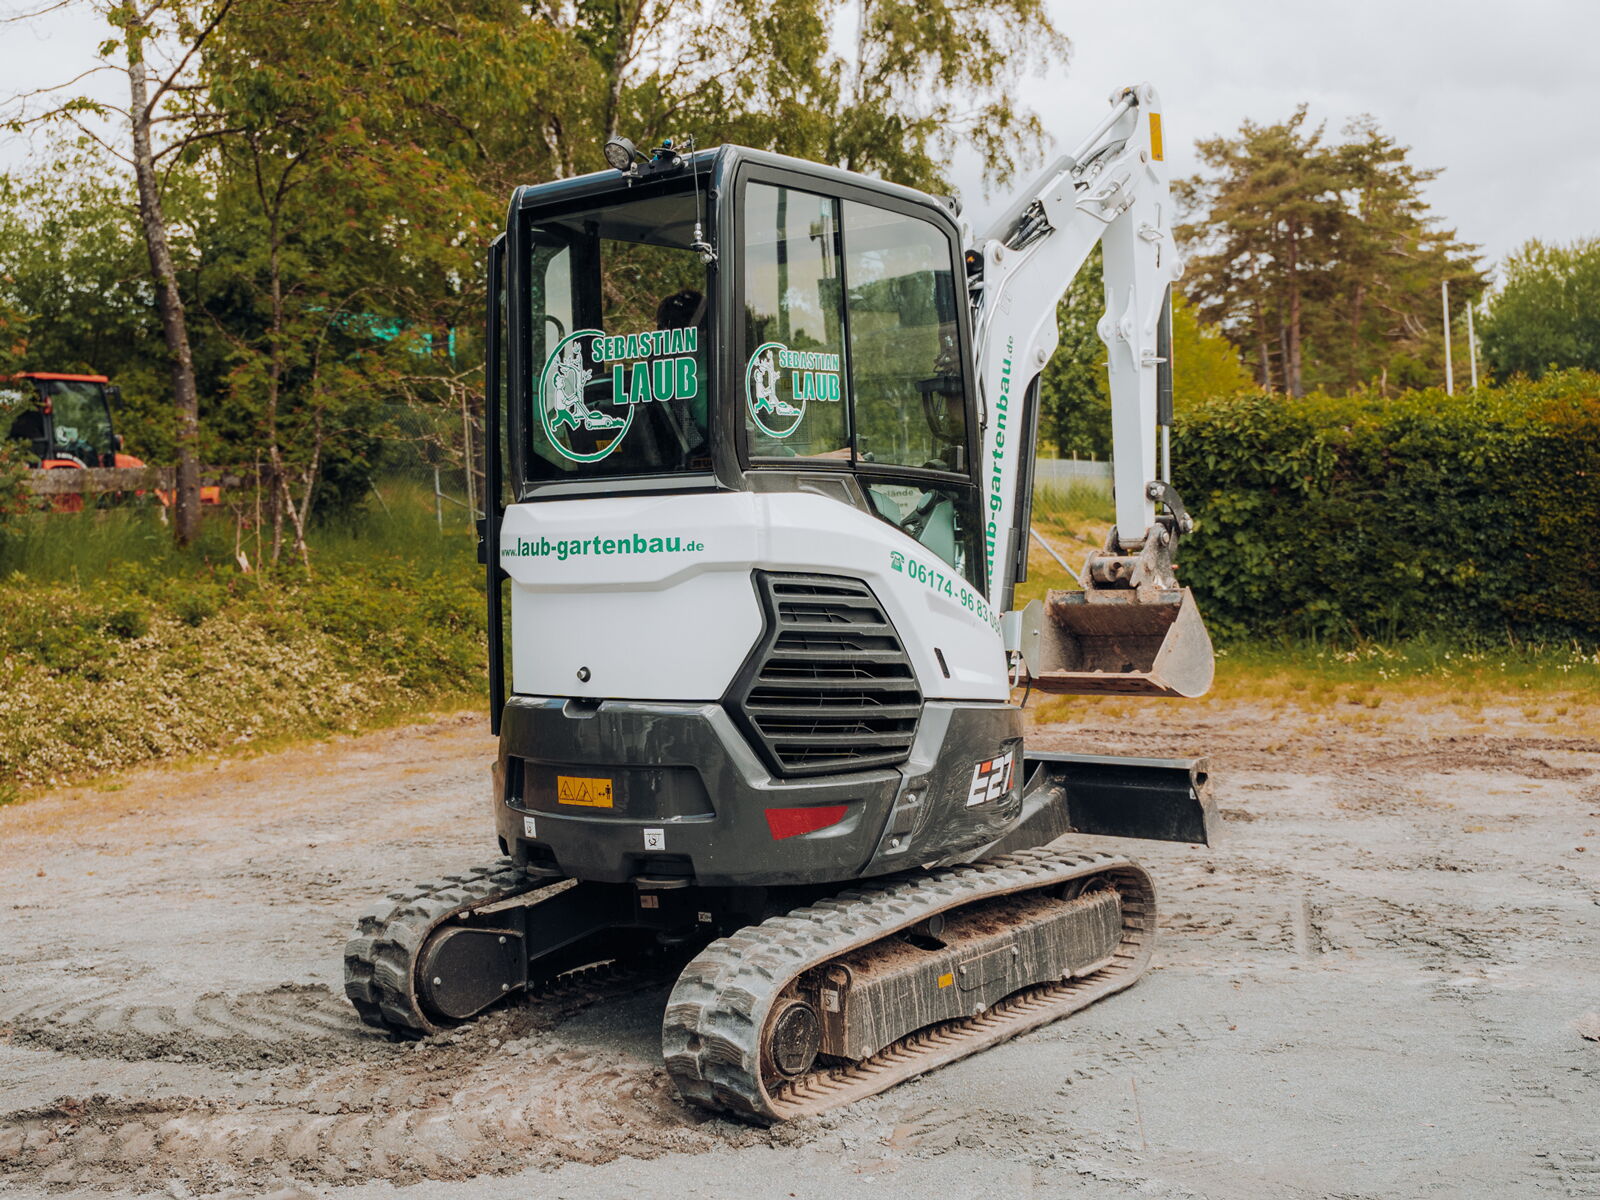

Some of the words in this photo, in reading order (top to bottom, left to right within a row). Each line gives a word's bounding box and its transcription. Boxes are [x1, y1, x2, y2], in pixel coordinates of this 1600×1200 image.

[592, 326, 697, 362] SEBASTIAN
[779, 350, 839, 371] SEBASTIAN
[613, 357, 697, 405] LAUB
[792, 371, 840, 401] LAUB
[501, 533, 704, 560] www.laub-gartenbau.de
[977, 600, 988, 622] 83
[966, 751, 1014, 806] E27
